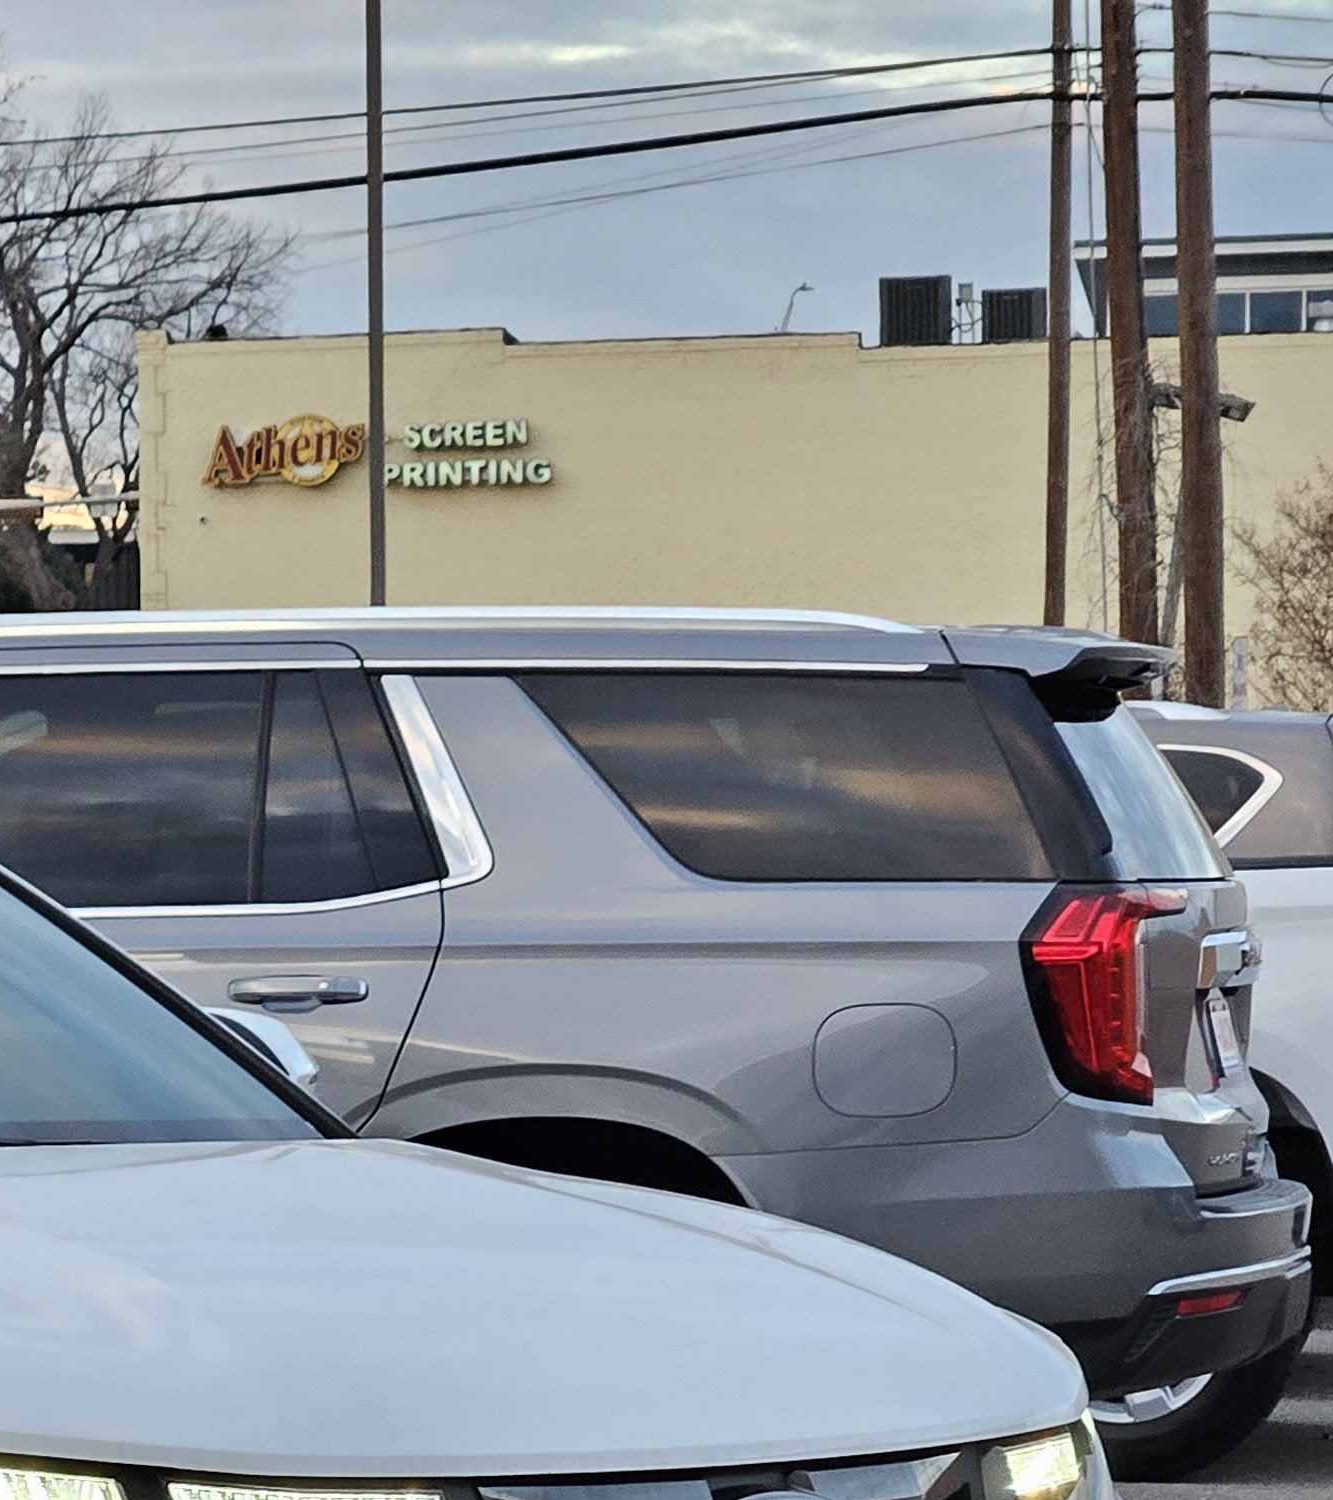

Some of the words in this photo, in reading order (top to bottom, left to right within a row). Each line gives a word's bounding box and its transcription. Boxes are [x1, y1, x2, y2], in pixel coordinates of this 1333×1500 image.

[403, 419, 529, 450] SCREEN
[201, 422, 365, 486] Athens
[383, 458, 552, 487] PRINTING
